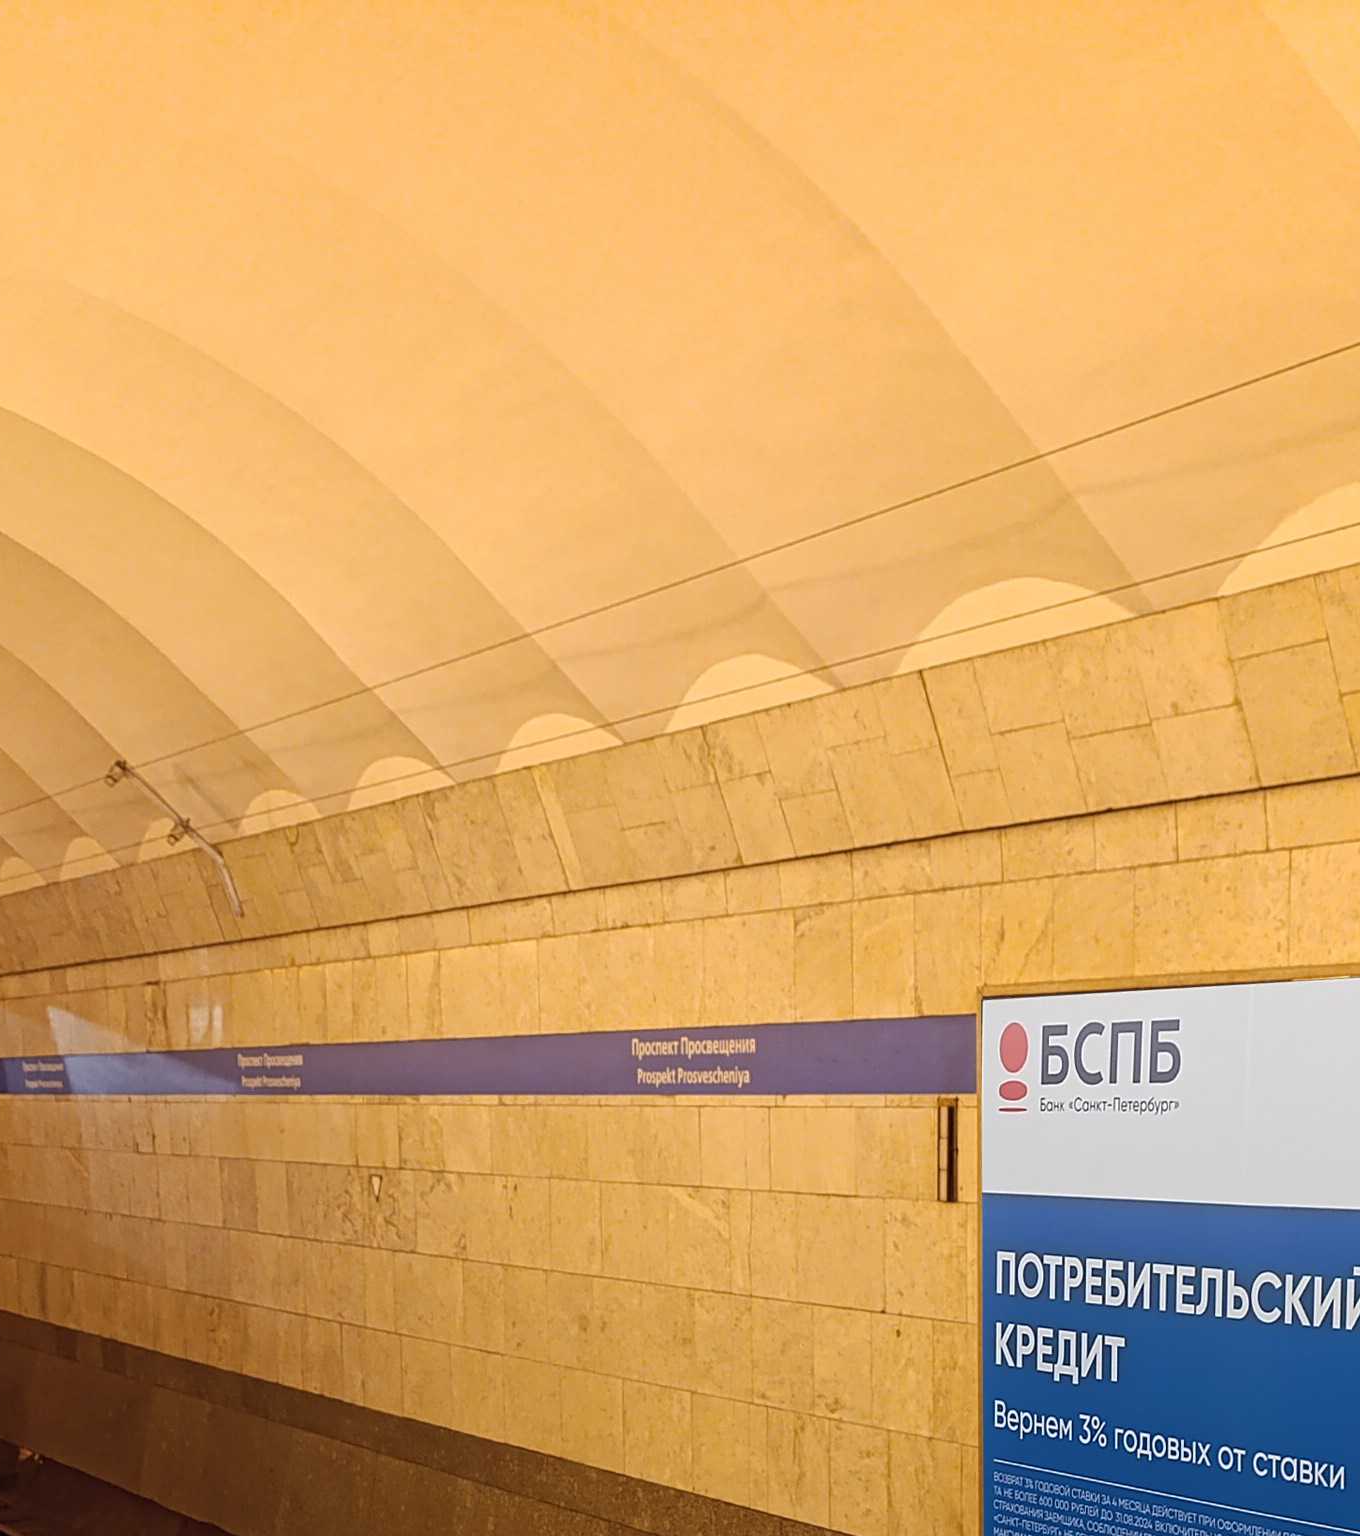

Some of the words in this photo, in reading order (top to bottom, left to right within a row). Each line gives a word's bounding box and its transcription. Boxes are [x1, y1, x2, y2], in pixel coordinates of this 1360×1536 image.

[632, 1038, 679, 1058] Проспект
[680, 1036, 756, 1059] Просвещения
[1041, 1019, 1181, 1085] БСПБ
[637, 1067, 676, 1087] Prospekt
[677, 1066, 750, 1087] Prosvescheniya
[1040, 1097, 1065, 1112] Банк
[1068, 1097, 1180, 1115] «Санкт-Петербург»
[994, 1322, 1126, 1384] КРЕДИТ
[993, 1399, 1073, 1442] Вернем
[1078, 1414, 1108, 1448] 3%
[1114, 1427, 1210, 1467] годовых
[1217, 1445, 1246, 1472] от
[1252, 1452, 1346, 1491] ставки
[1198, 1513, 1215, 1528] ПРИ
